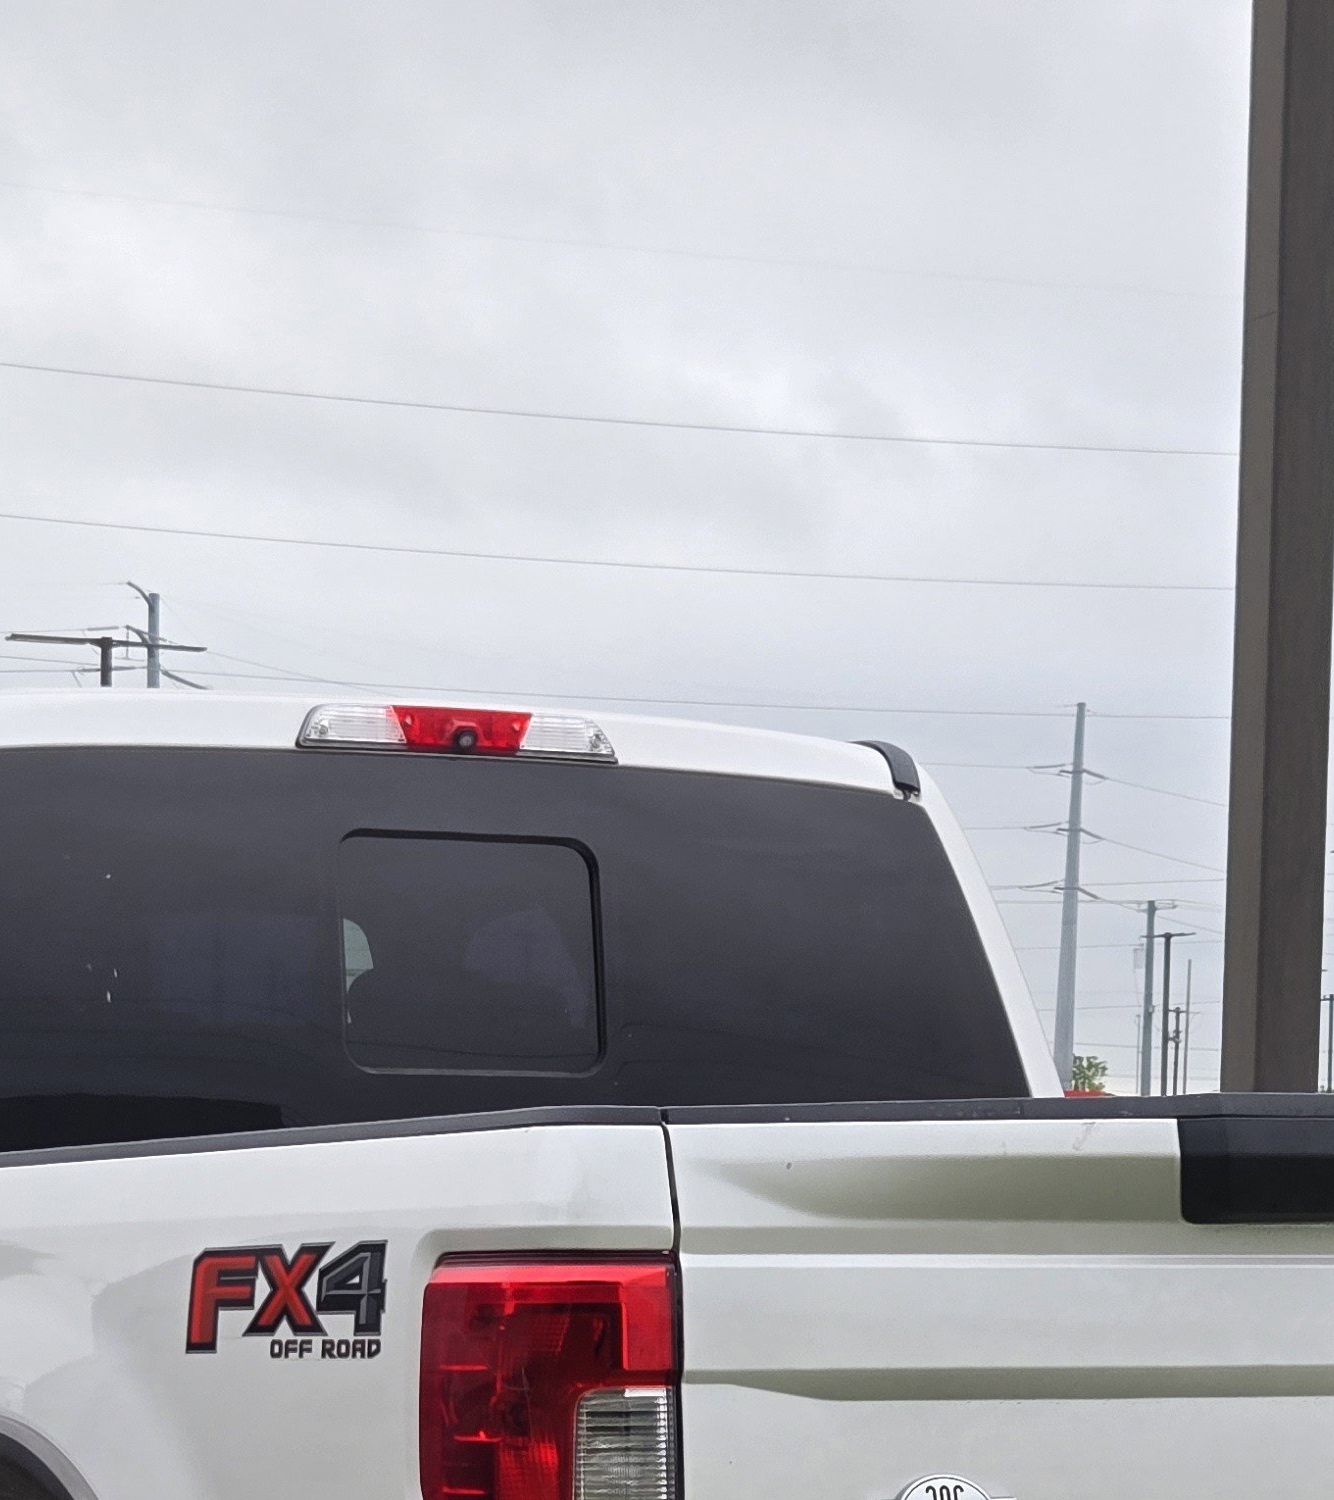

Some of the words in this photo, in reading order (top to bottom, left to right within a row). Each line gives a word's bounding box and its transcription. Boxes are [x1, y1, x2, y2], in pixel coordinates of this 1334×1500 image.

[186, 1240, 388, 1354] FX4
[270, 1339, 313, 1359] OFF
[321, 1339, 381, 1359] ROAD
